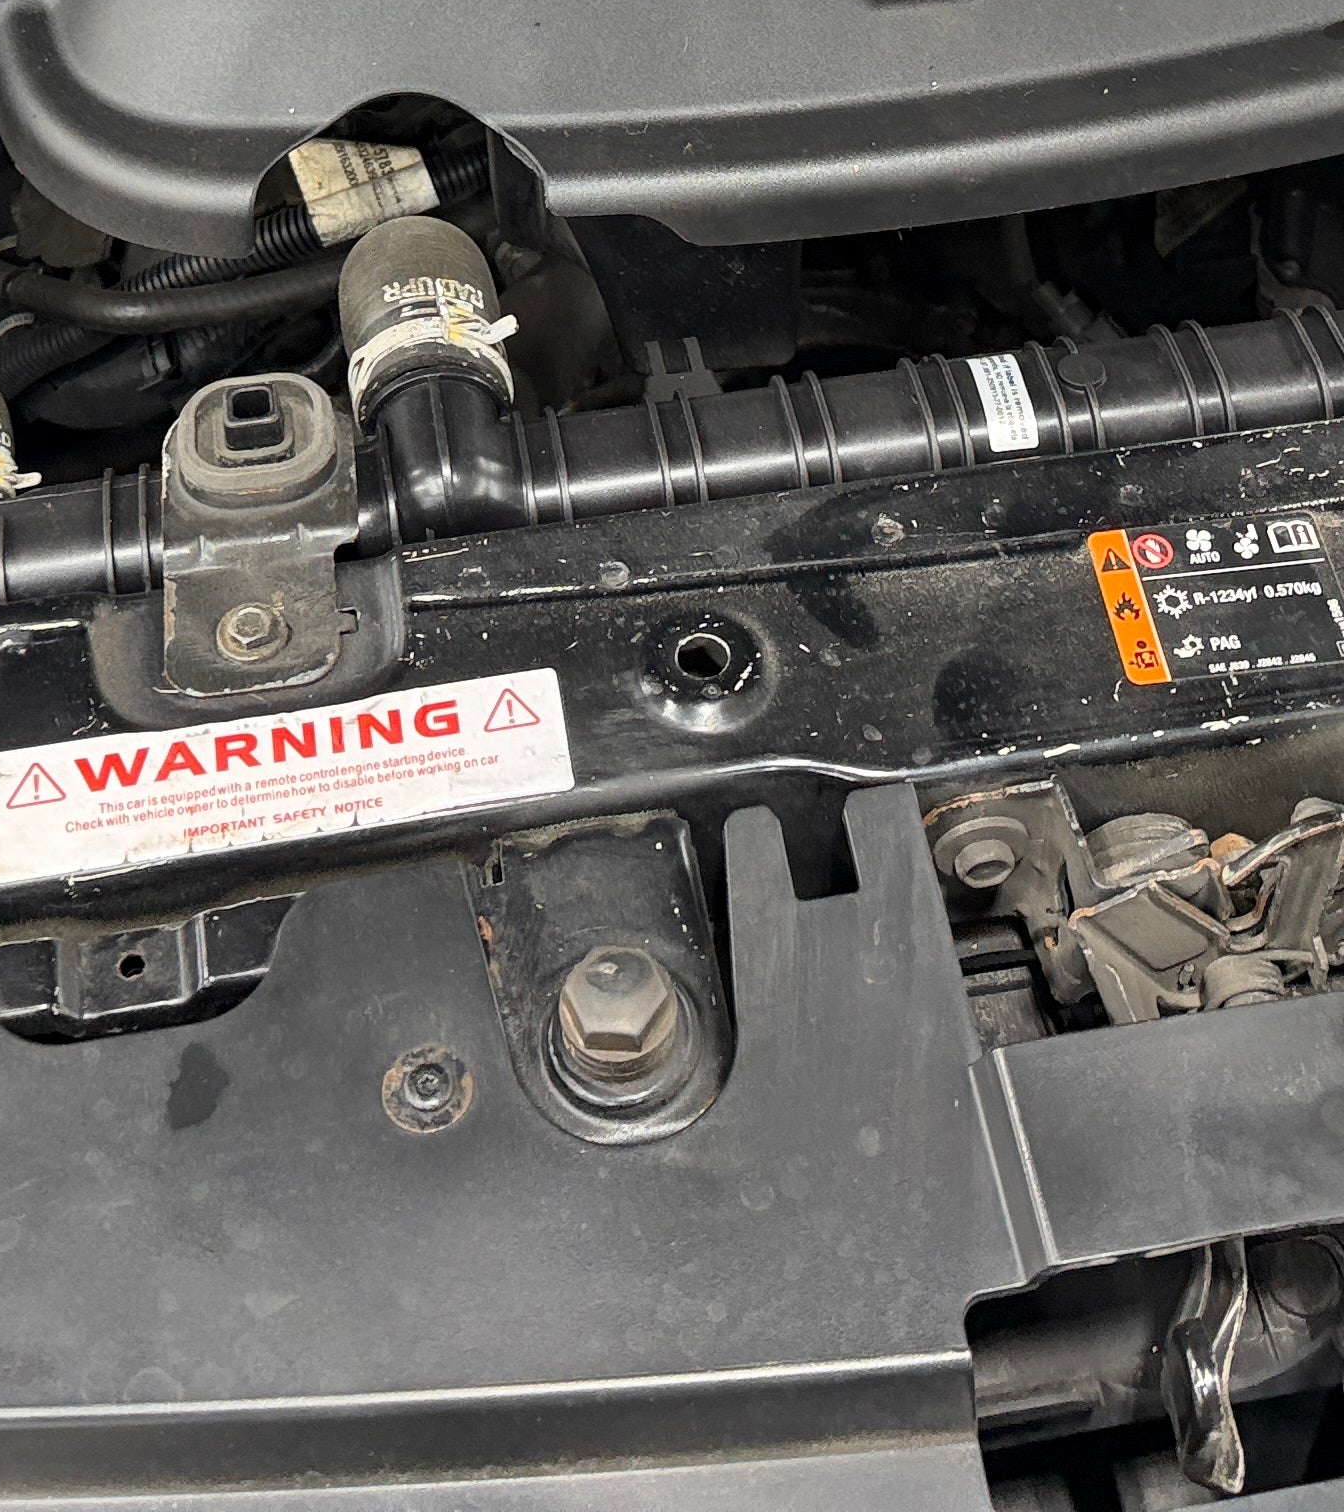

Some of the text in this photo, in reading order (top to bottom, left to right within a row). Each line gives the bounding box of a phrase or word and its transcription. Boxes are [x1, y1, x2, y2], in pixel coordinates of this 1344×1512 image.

[1189, 551, 1221, 564] AUTO
[1193, 581, 1322, 605] R-1234yf 0.570kg
[1209, 634, 1242, 652] PAG
[1208, 662, 1228, 673] SAE
[74, 699, 459, 793] WARNING
[65, 754, 499, 834] Check with vehicle owner to determine how to disable before working on car
[99, 802, 124, 814] This
[127, 798, 145, 812] car
[148, 794, 158, 807] is
[160, 786, 216, 806] equipped
[217, 783, 242, 795] with
[244, 781, 252, 791] a
[255, 774, 297, 789] remote
[299, 766, 339, 782] control
[340, 761, 380, 777] engine
[382, 753, 426, 770] starting
[183, 797, 384, 838] IMPORTANT SAFETY NOTICE
